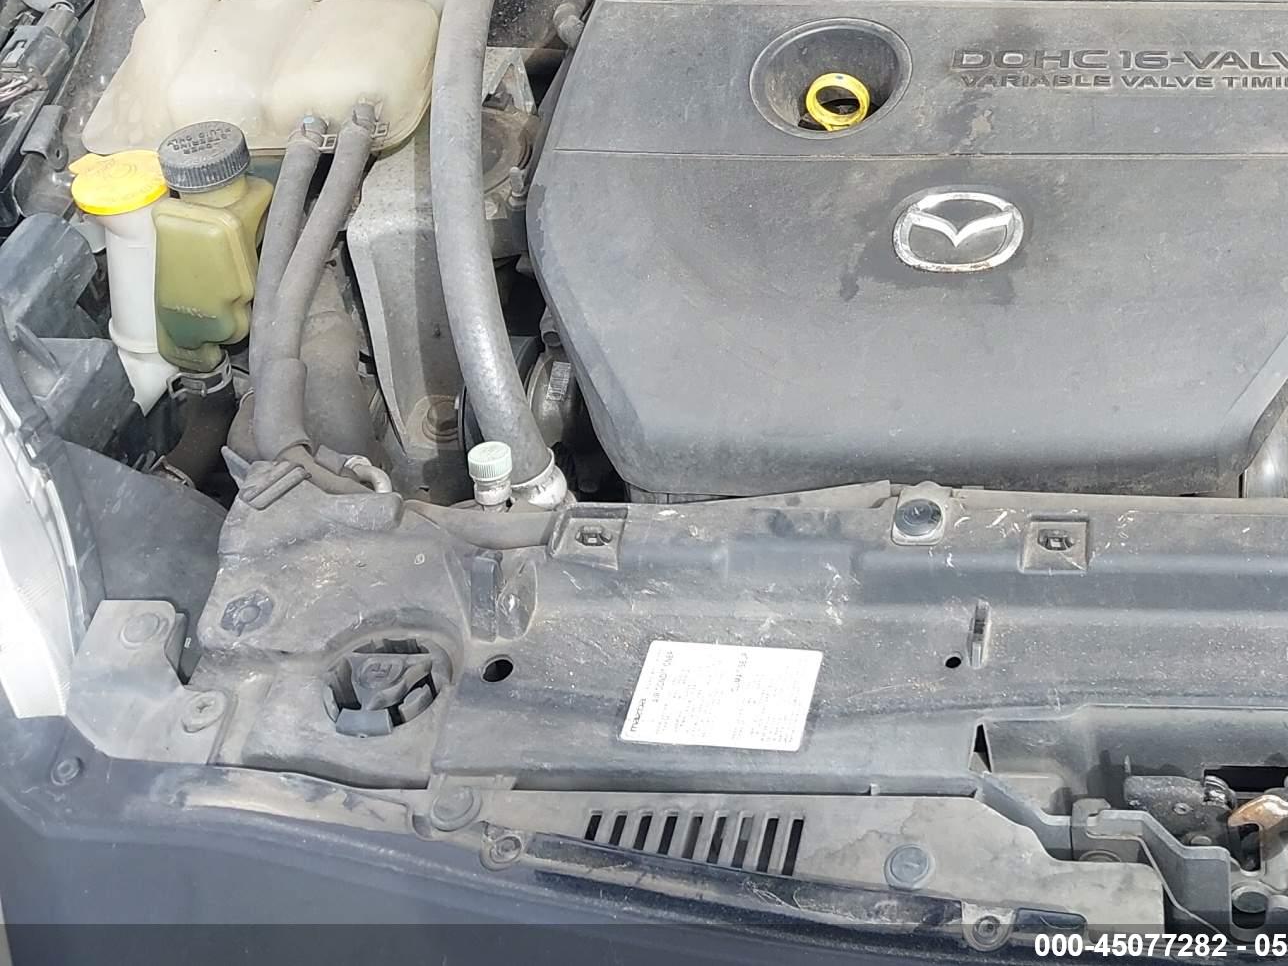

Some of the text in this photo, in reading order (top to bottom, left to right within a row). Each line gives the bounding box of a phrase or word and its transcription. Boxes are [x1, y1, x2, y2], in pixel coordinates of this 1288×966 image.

[952, 48, 1111, 70] DOHC
[961, 74, 1112, 89] VARIABLE
[1121, 75, 1214, 89] VALVE
[167, 135, 193, 147] ONLY
[630, 698, 647, 732] mazda
